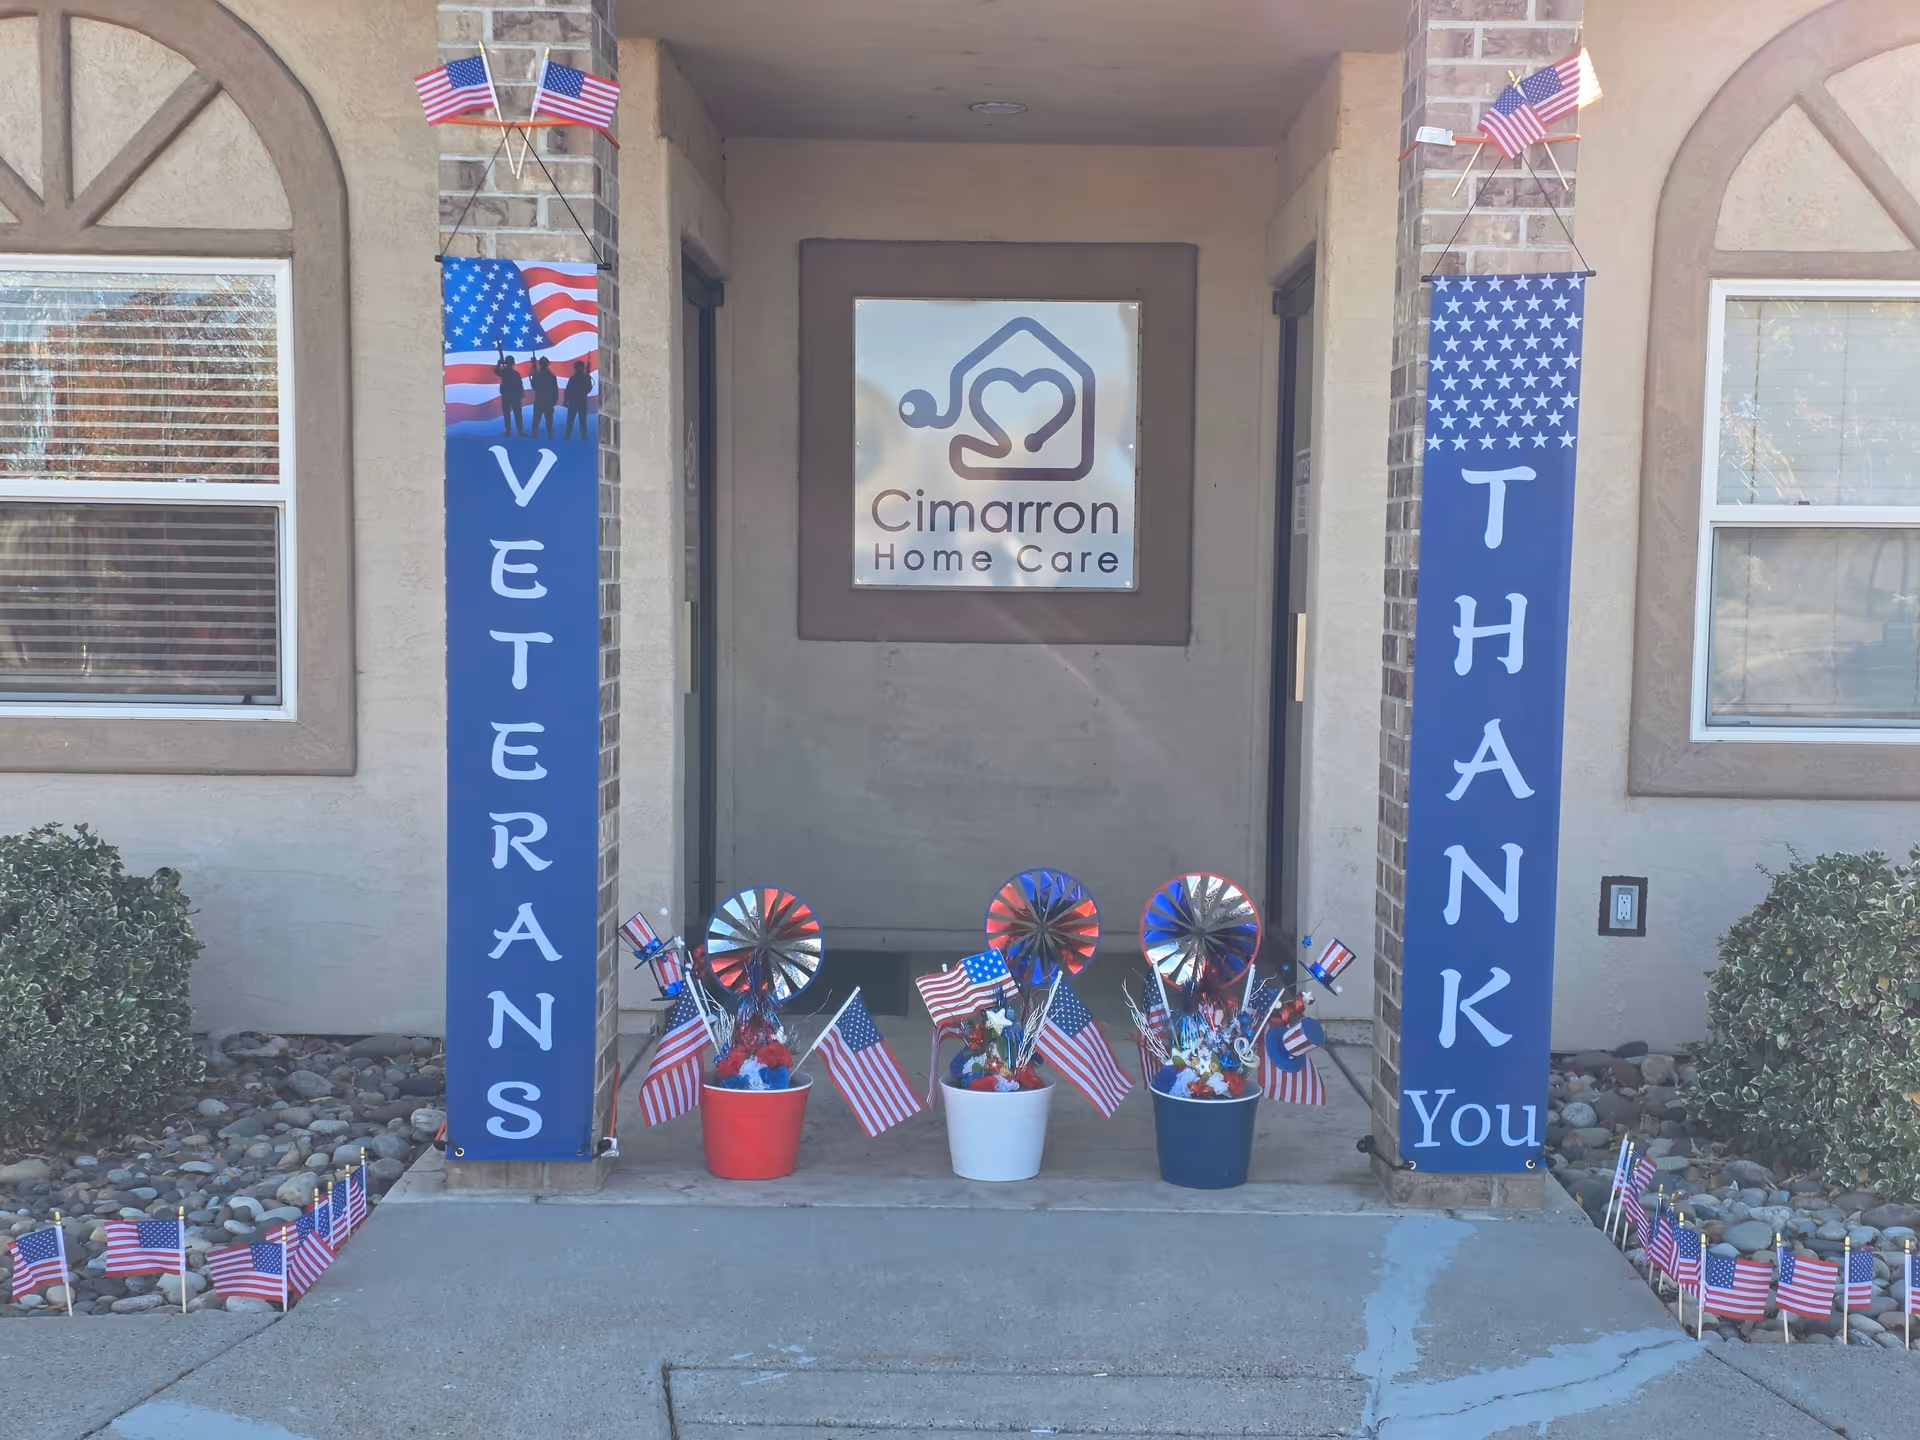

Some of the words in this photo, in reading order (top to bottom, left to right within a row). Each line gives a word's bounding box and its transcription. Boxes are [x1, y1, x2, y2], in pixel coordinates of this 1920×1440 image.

[871, 488, 1119, 534] Cimarron
[874, 542, 992, 572] Home
[1016, 544, 1119, 573] Care
[1438, 465, 1537, 1049] THANK
[486, 445, 563, 1140] VETERANS
[1403, 1088, 1541, 1148] You
